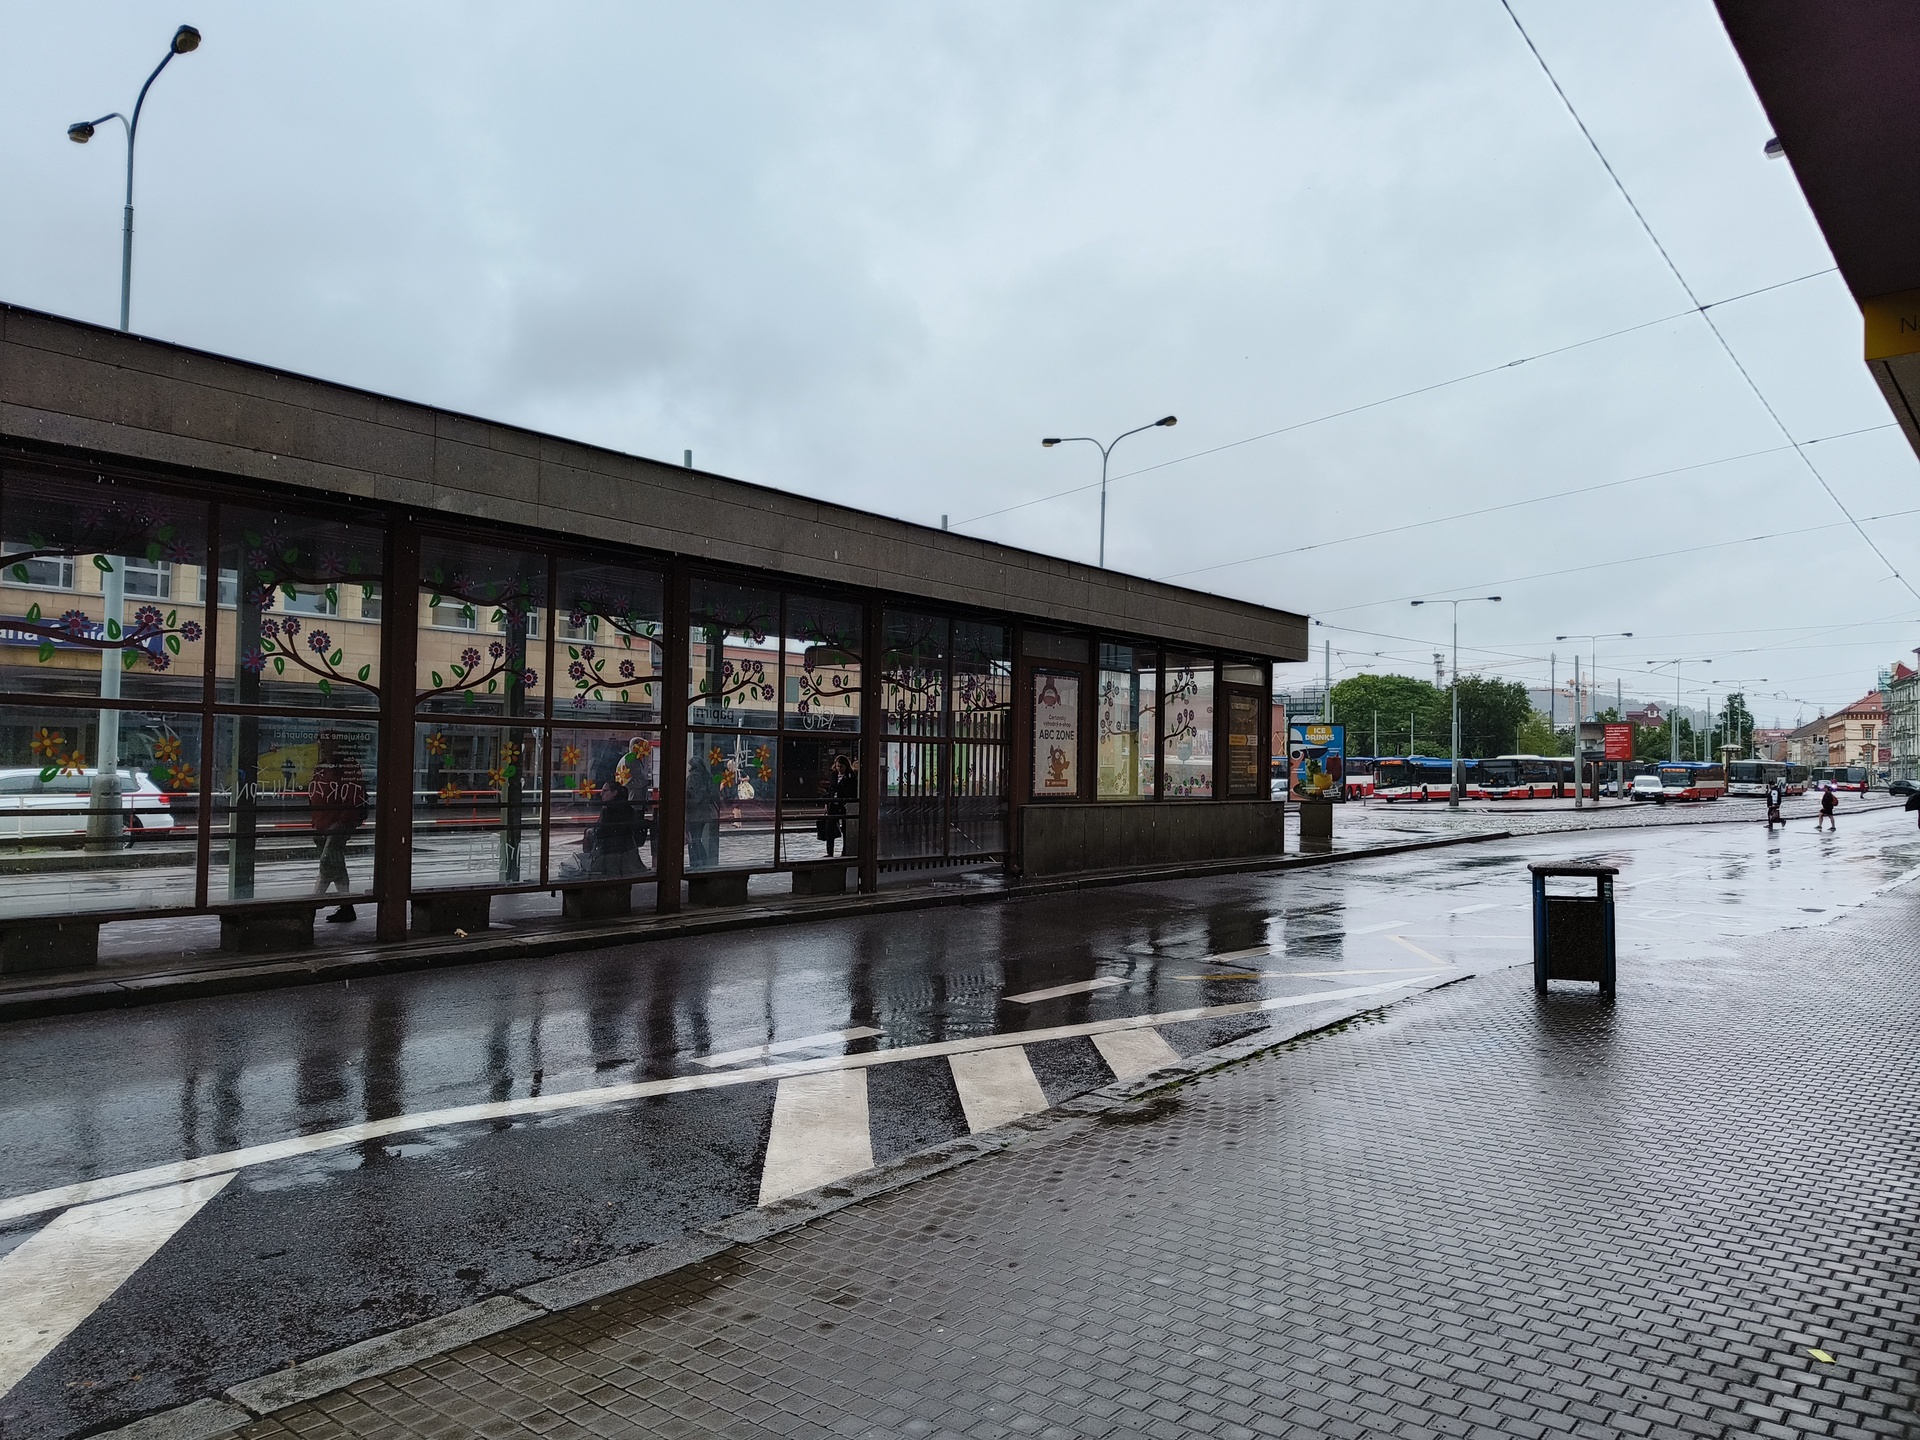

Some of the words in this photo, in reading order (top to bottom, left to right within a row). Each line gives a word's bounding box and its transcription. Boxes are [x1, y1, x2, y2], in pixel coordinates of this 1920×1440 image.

[1901, 314, 1920, 334] N
[1039, 729, 1055, 740] ABC
[1056, 729, 1074, 740] ZONE
